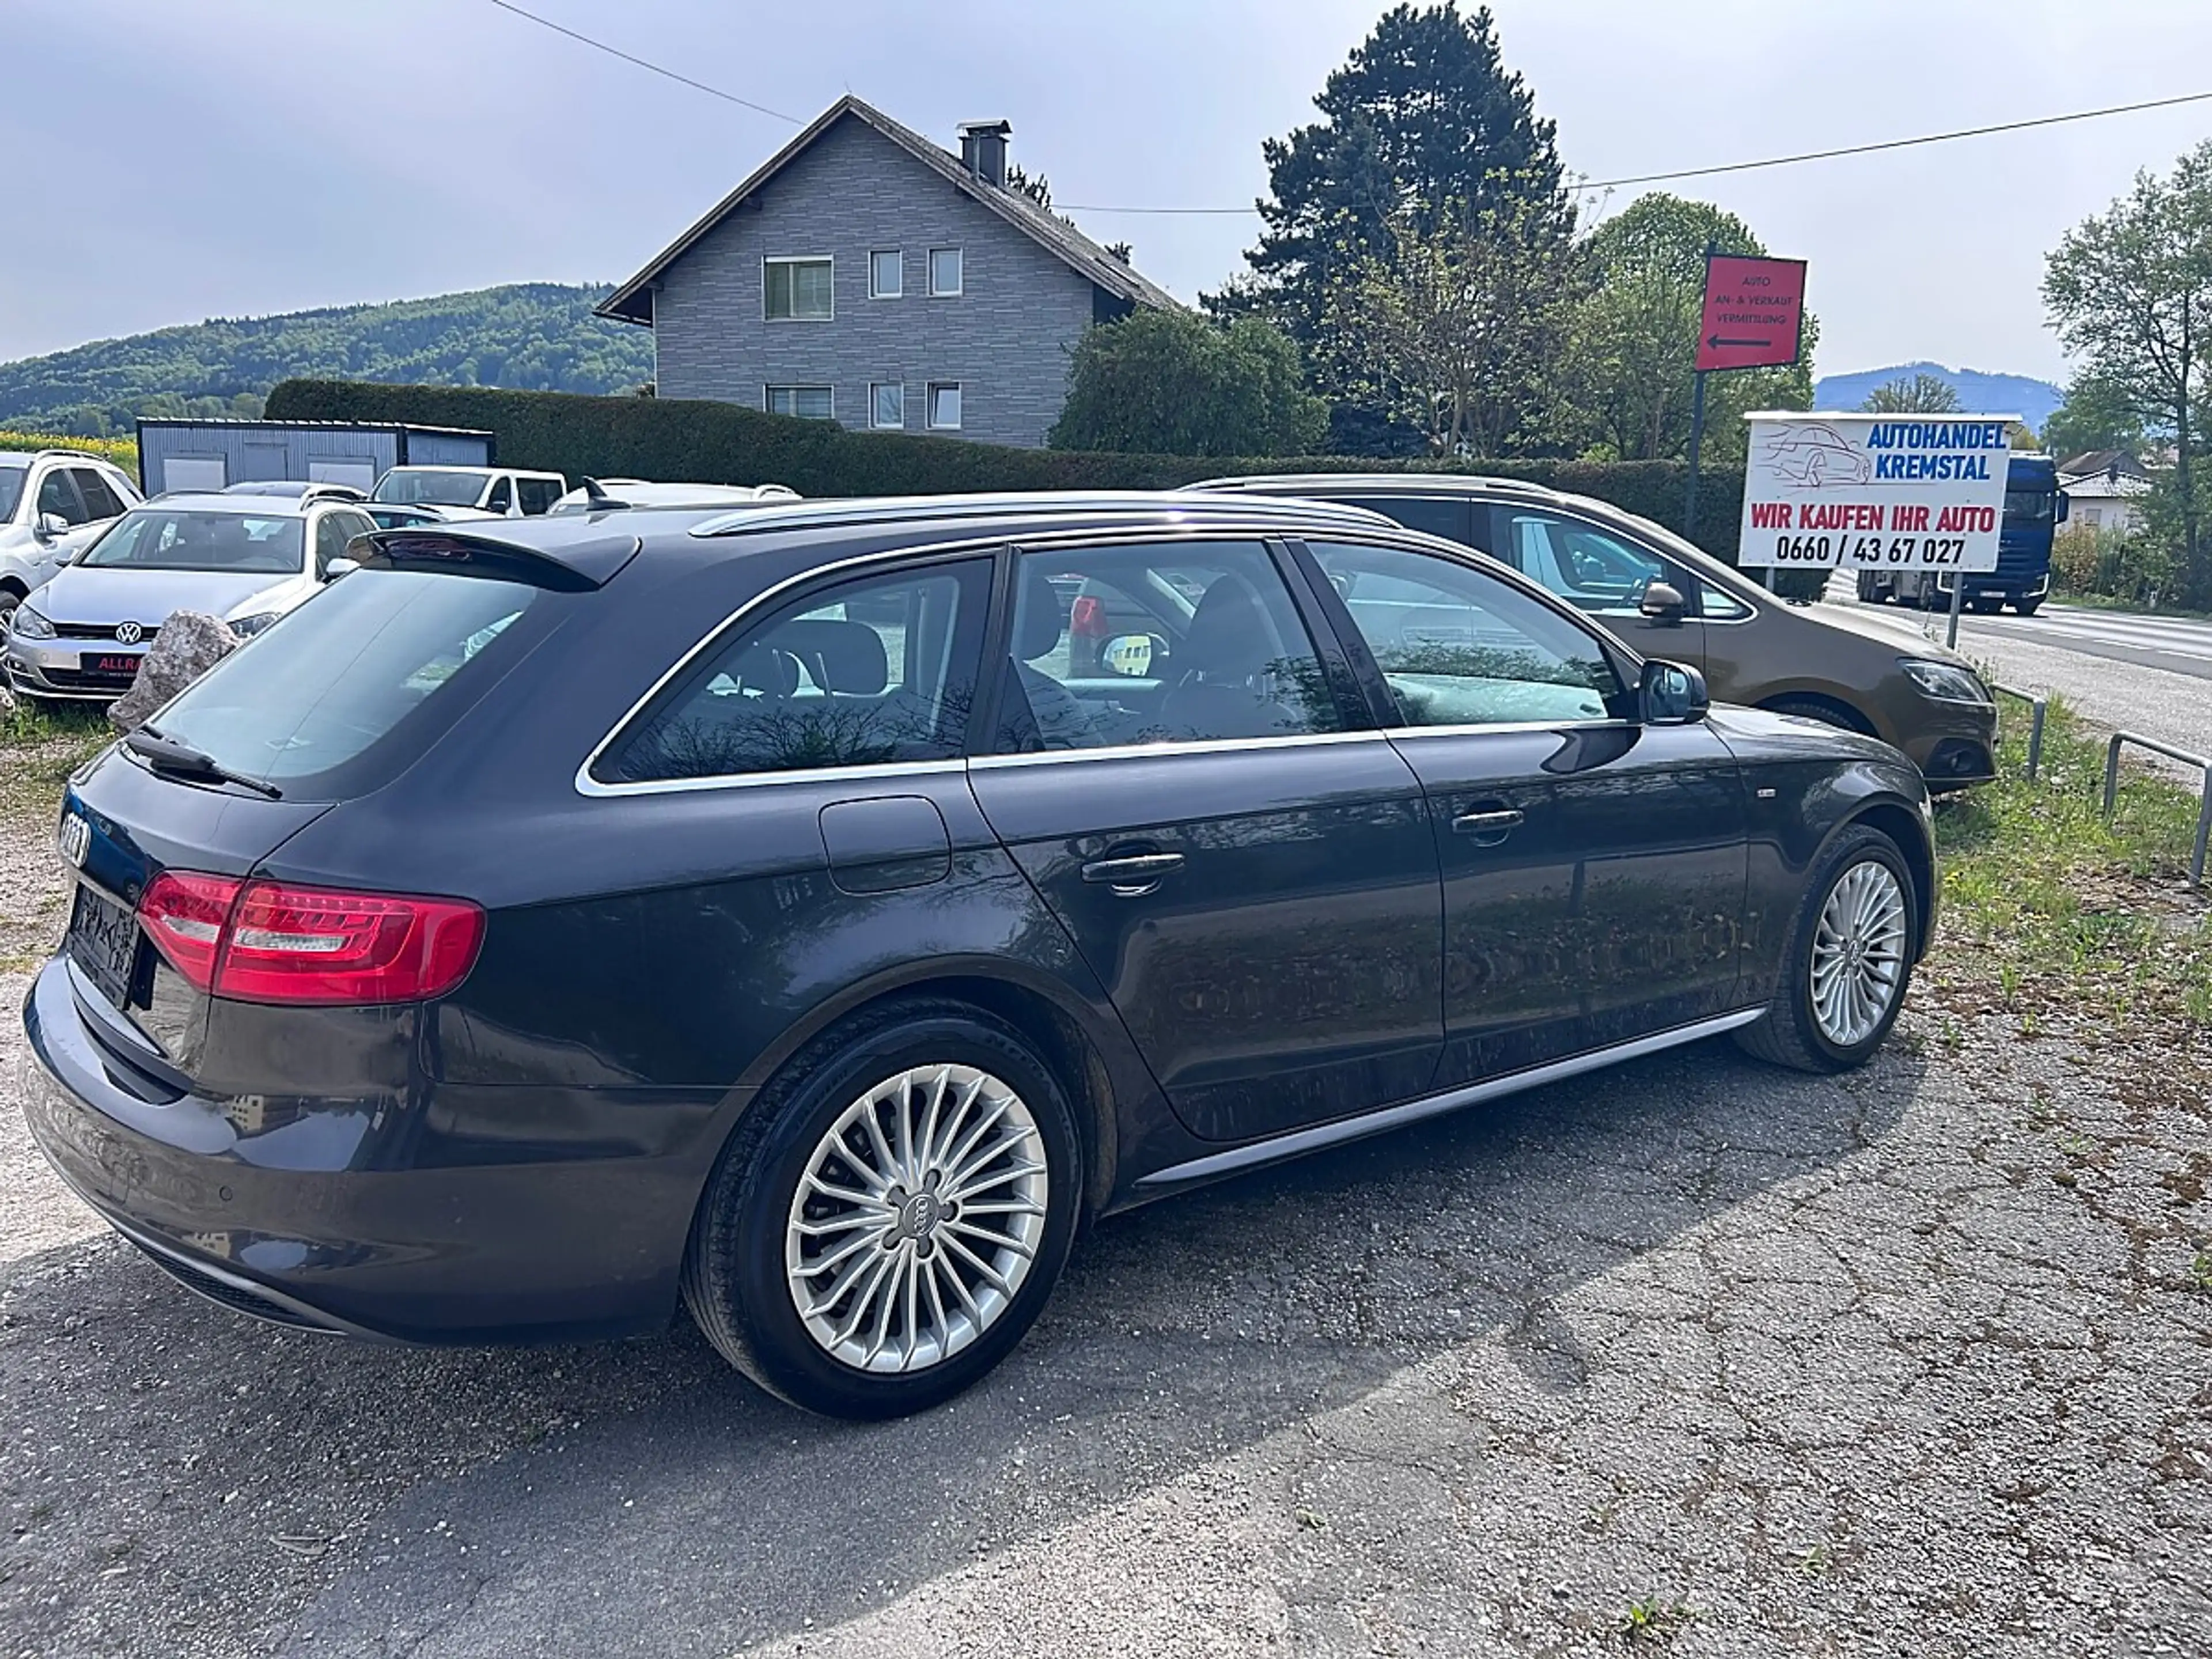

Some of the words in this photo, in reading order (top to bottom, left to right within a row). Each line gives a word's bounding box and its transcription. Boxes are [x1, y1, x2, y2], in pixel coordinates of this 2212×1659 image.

[1742, 276, 1771, 286] AUTO
[1736, 295, 1745, 305] &
[1748, 296, 1793, 306] VERKAUF
[1717, 313, 1786, 324] VERMITTLUNG
[1867, 423, 2006, 449] AUTOHANDEL
[1875, 454, 1990, 480] KREMSTAL
[1751, 503, 1793, 528] WIR
[1799, 504, 1884, 531] KAUFEN
[1891, 506, 1929, 532] IHR
[1935, 506, 1995, 533] AUTO
[1777, 536, 1830, 561] 0660
[1835, 535, 1848, 565] /
[1853, 537, 1881, 562] 43
[1888, 538, 1916, 563] 67
[1922, 539, 1965, 564] 027
